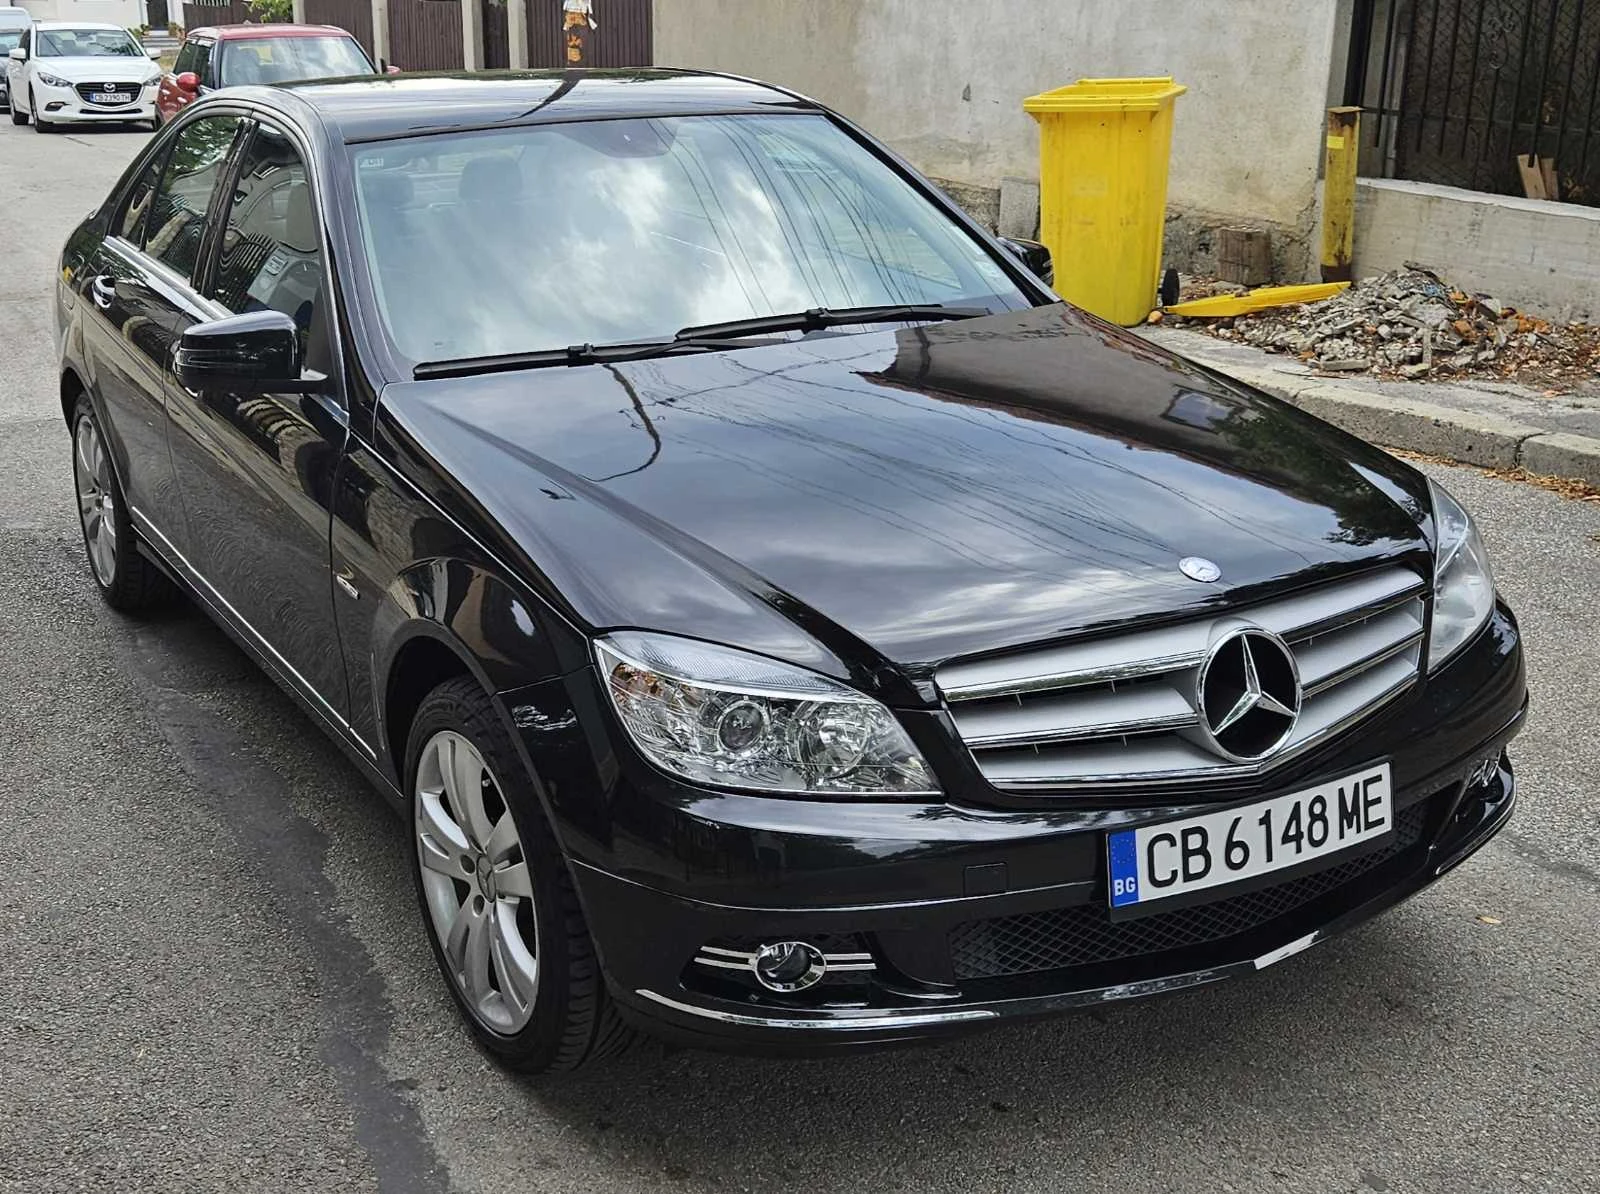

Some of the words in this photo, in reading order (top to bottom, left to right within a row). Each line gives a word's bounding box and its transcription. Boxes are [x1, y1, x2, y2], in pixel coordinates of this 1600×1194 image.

[1147, 825, 1212, 888] CB
[1224, 795, 1329, 870] 6148
[1338, 774, 1385, 840] ME
[1114, 879, 1136, 896] BG
